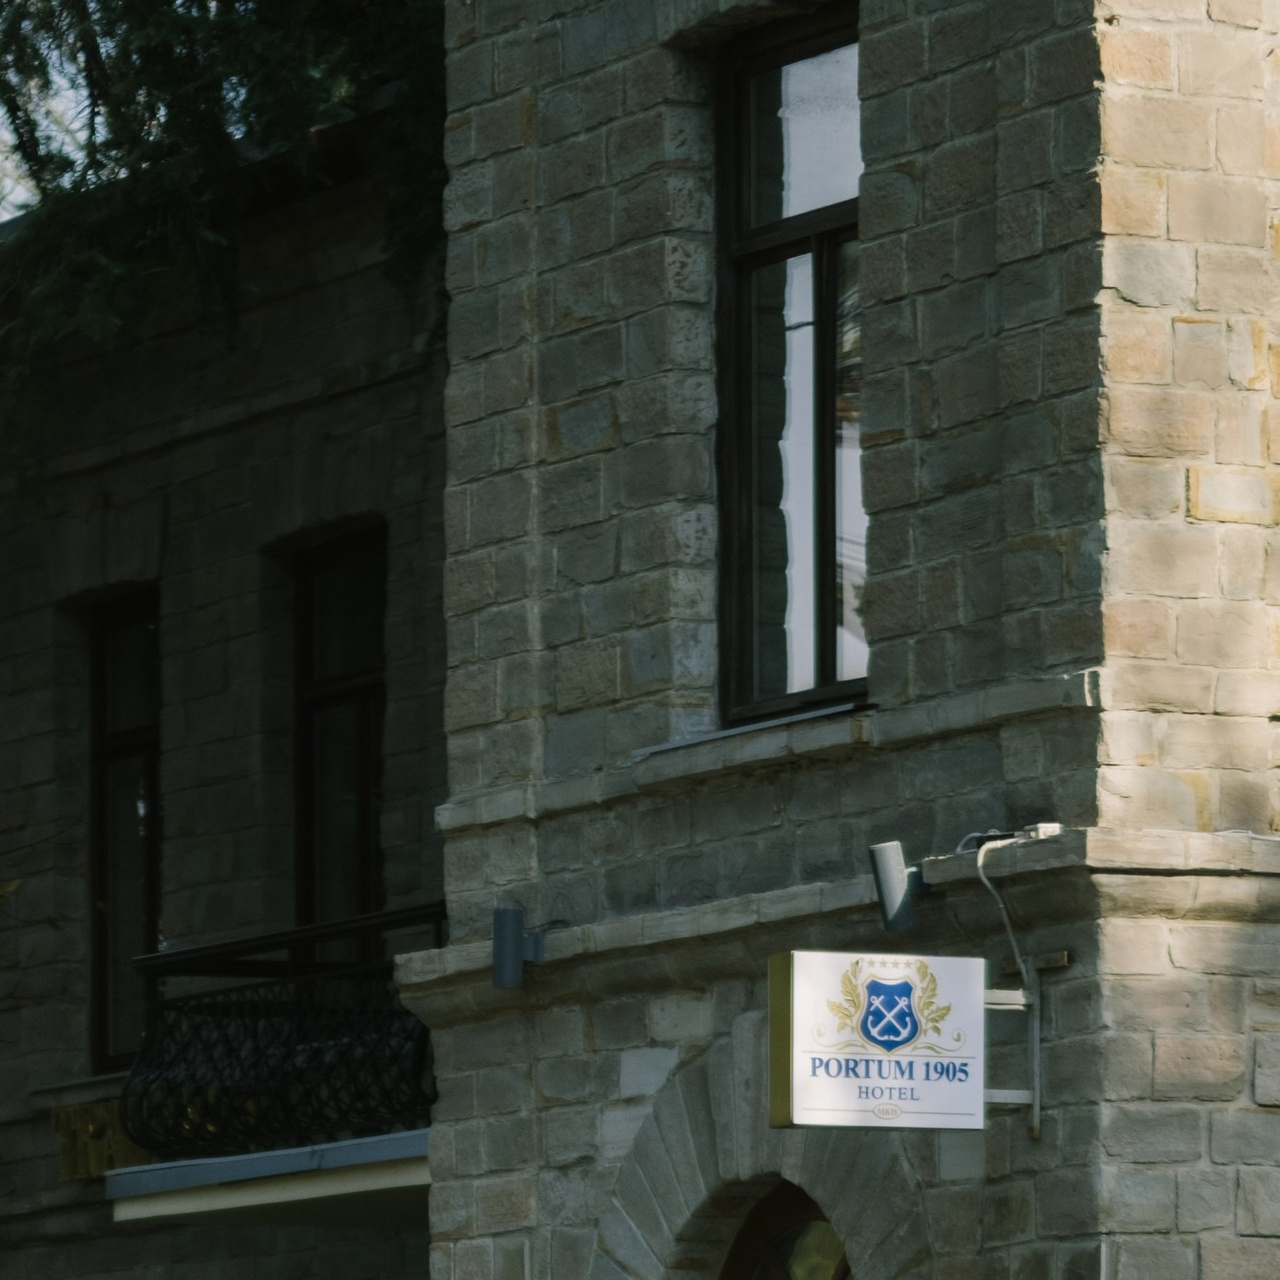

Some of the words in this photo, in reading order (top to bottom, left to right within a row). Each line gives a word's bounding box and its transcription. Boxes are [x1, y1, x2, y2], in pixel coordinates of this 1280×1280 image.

[810, 1057, 915, 1081] PORTUM
[923, 1061, 969, 1082] 1905
[858, 1086, 920, 1101] HOTEL
